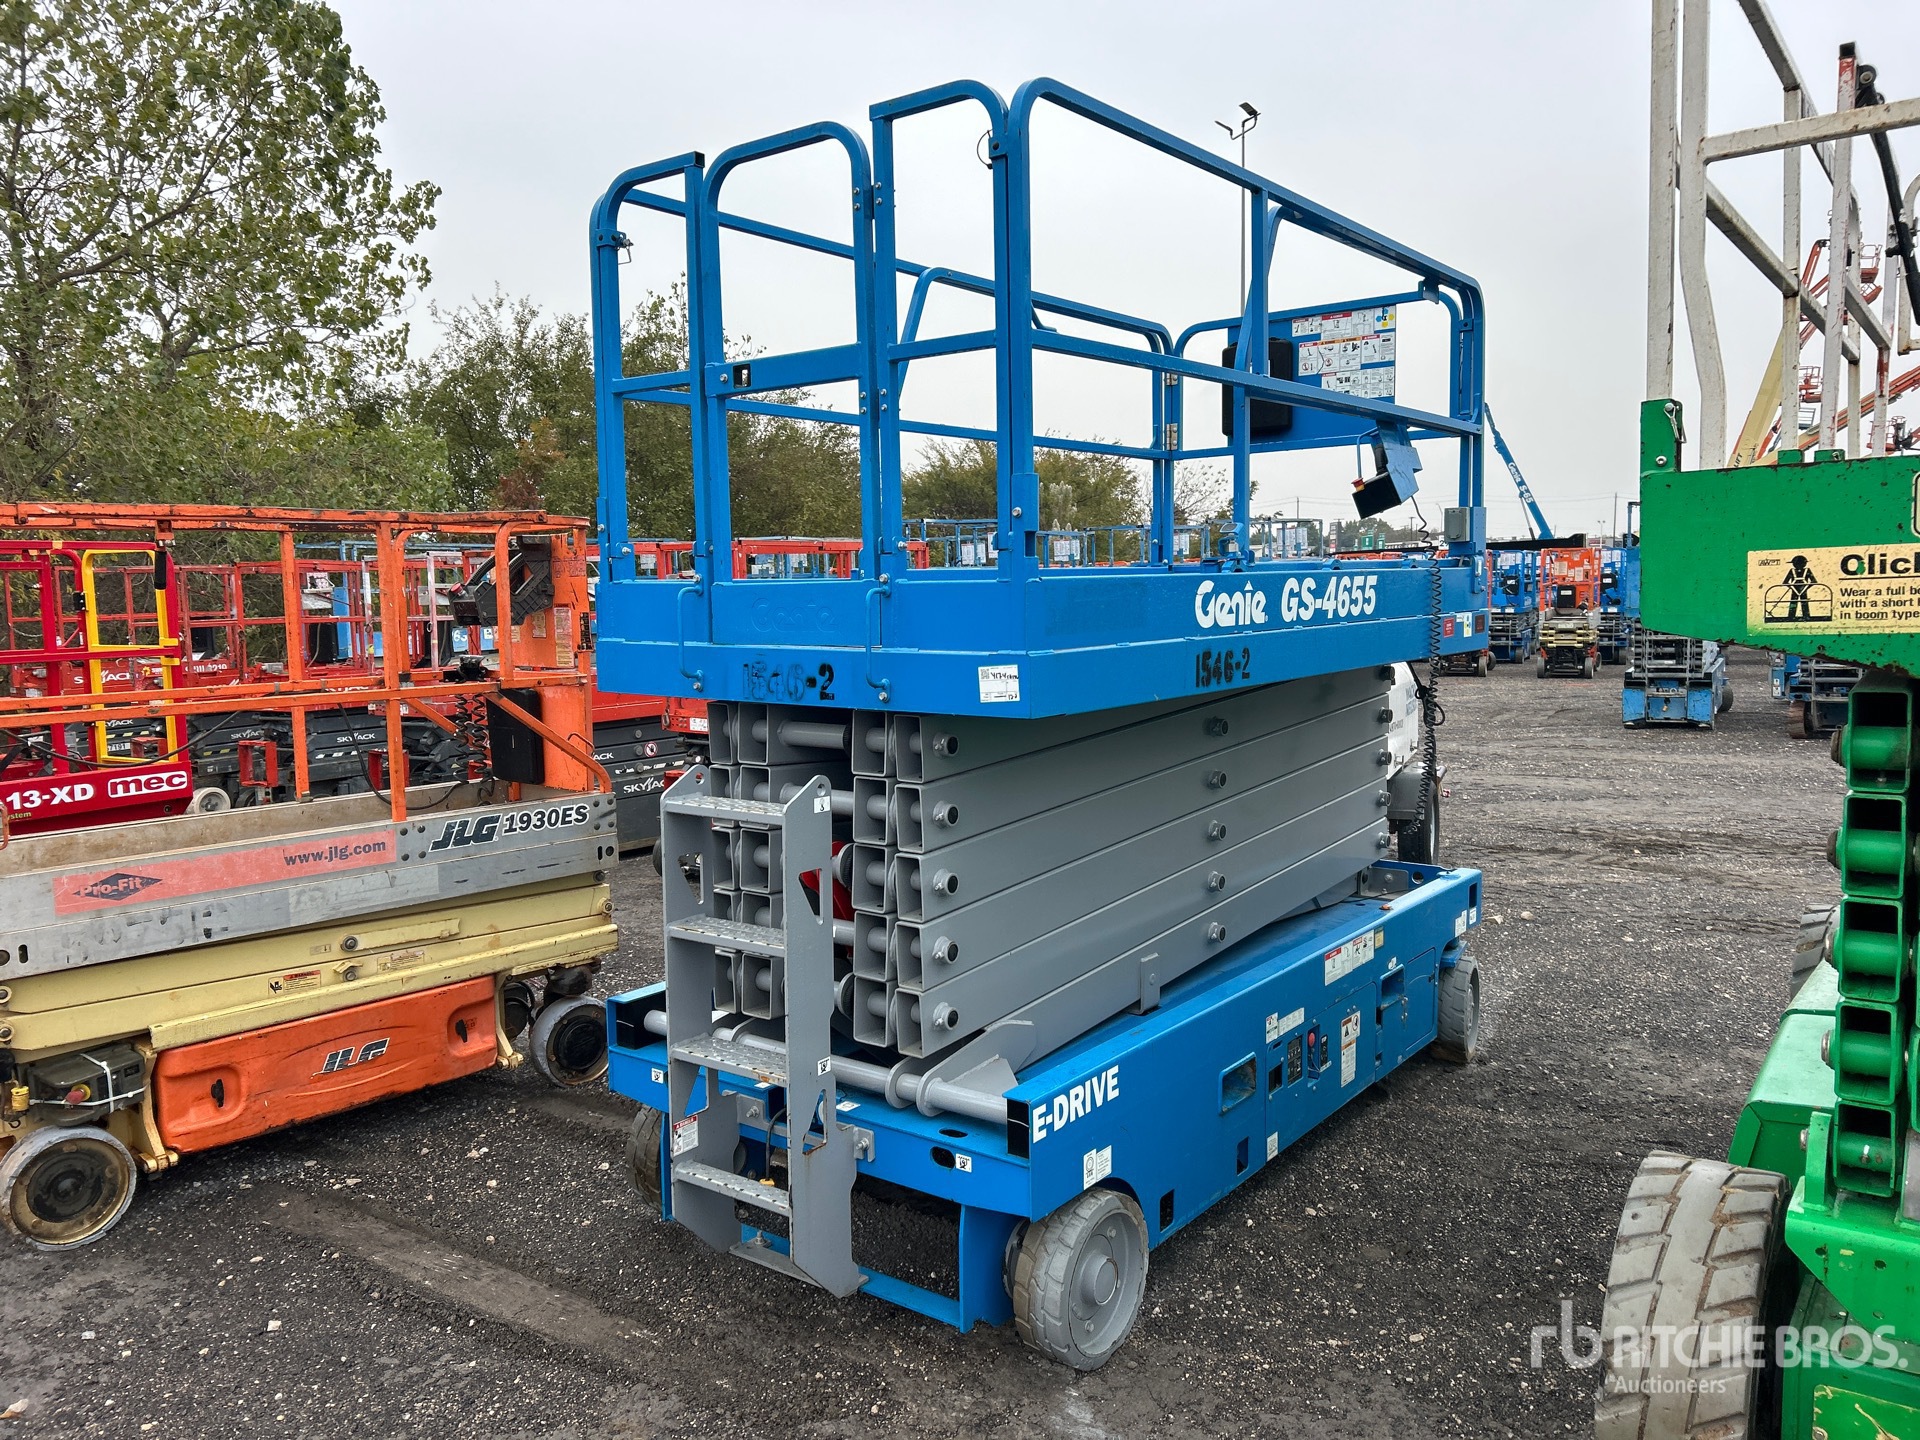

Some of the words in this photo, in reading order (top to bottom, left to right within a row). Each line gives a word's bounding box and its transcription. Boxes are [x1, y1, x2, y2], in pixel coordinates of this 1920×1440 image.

[1195, 579, 1268, 629] Genie
[1281, 574, 1378, 624] GS-4655
[1840, 587, 1871, 596] Wear
[1875, 588, 1882, 596] a
[1886, 586, 1905, 596] full
[1840, 599, 1866, 608] with
[1882, 598, 1914, 607] short
[1840, 611, 1851, 619] in
[1855, 610, 1888, 620] boom
[1196, 647, 1251, 689] 1546-2
[110, 773, 187, 796] mec
[623, 777, 665, 794] SKYJAC
[429, 815, 500, 852] JLG
[502, 804, 590, 835] 1930ES
[283, 839, 387, 867] www.jlg.com
[79, 877, 143, 898] Pro-Fit
[311, 1037, 390, 1079] JLG
[1032, 1064, 1120, 1144] E-DRIVE
